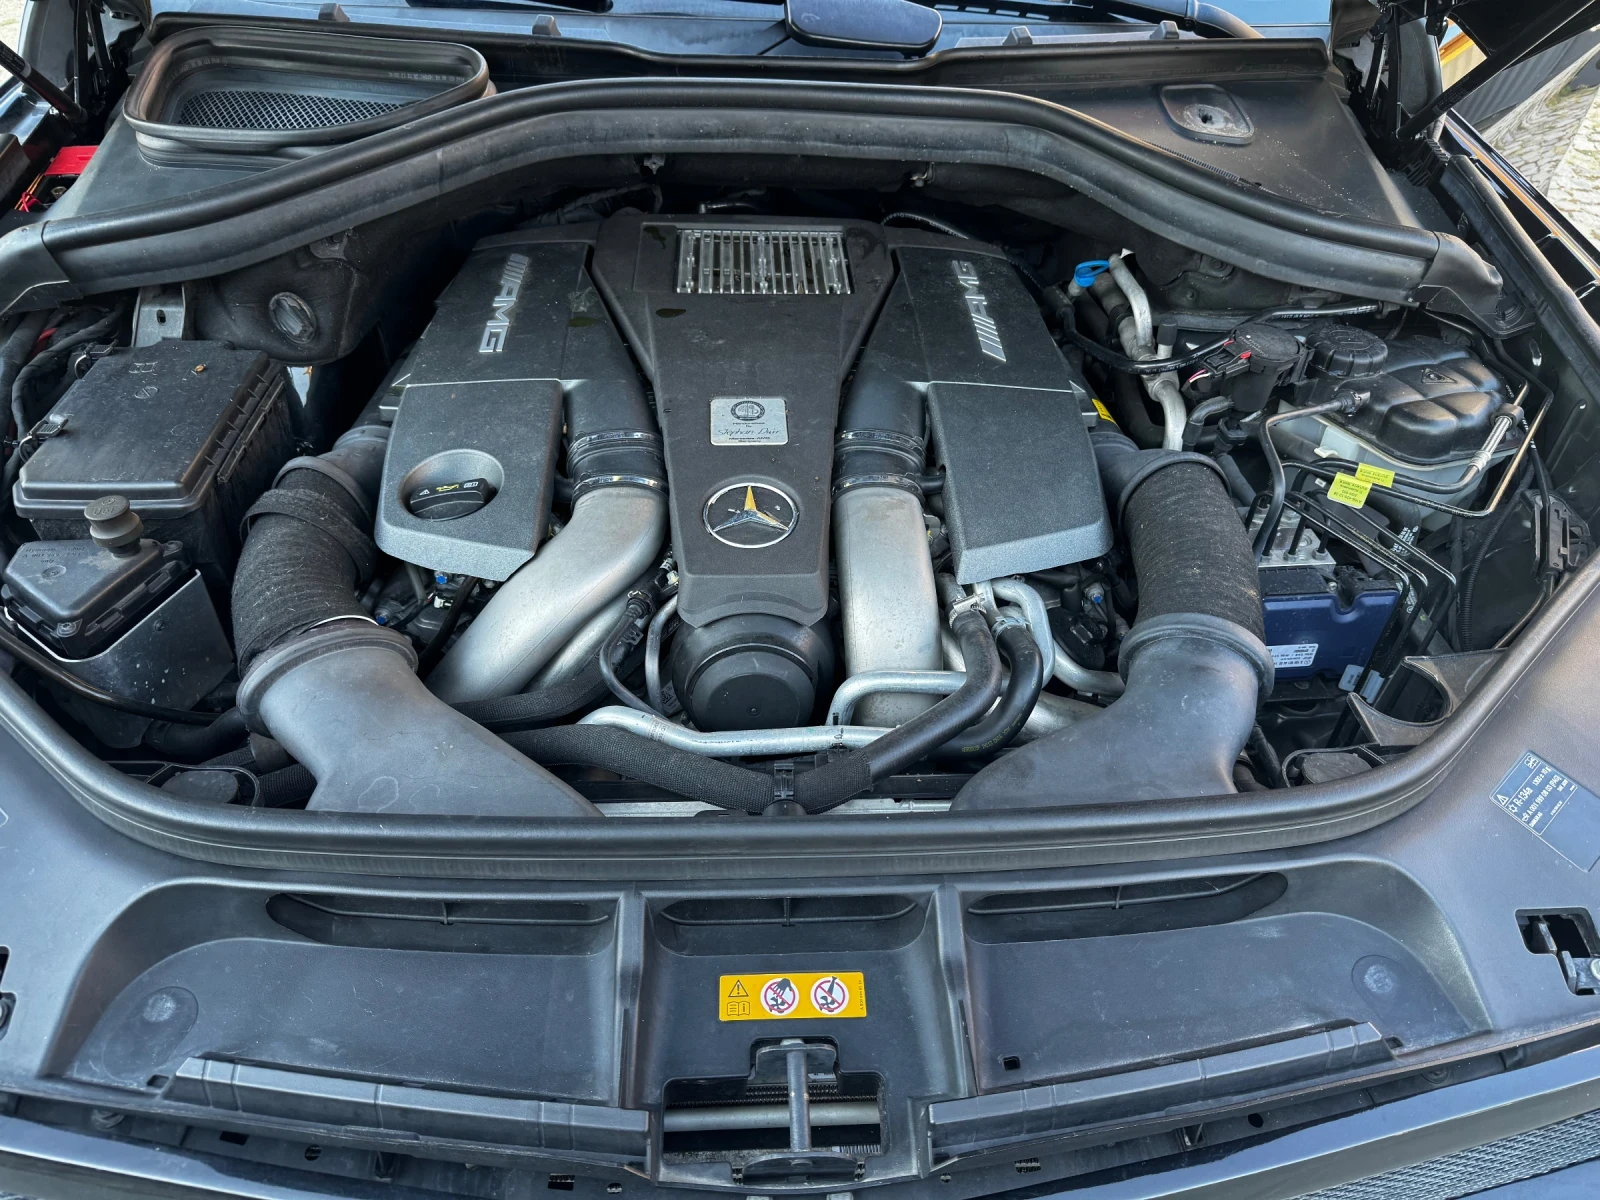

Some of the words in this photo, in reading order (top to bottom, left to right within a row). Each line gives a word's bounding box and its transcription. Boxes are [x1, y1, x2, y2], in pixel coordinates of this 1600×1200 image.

[479, 281, 521, 352] AMG
[952, 260, 994, 325] AMG
[1513, 787, 1533, 806] R-134a
